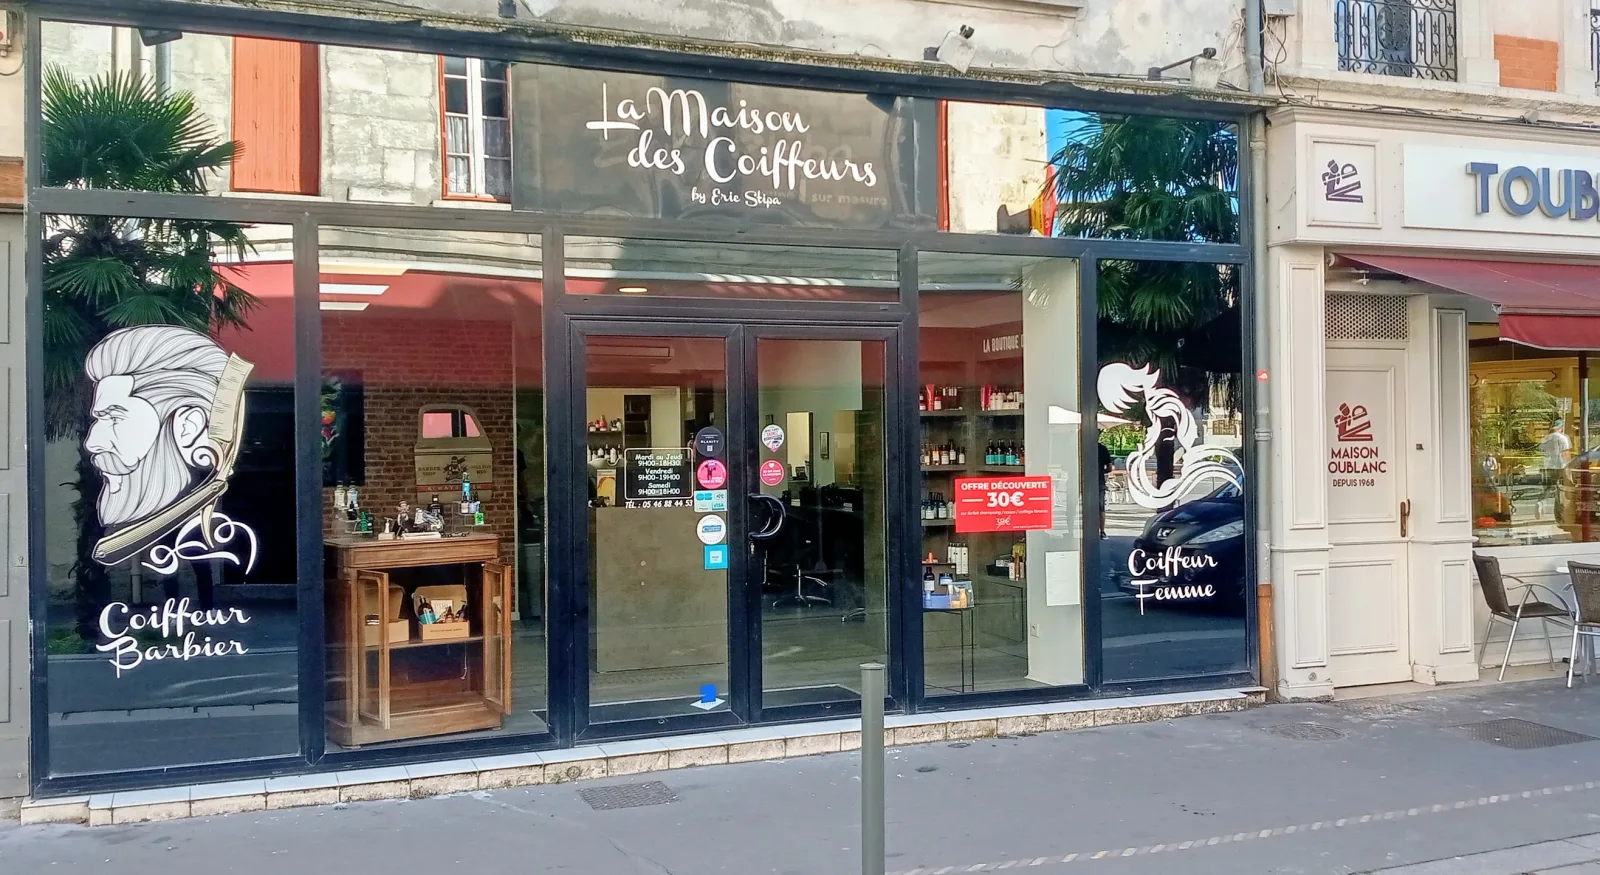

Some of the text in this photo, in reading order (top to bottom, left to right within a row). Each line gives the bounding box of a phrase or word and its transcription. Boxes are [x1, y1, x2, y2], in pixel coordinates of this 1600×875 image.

[586, 83, 810, 140] La Maison
[627, 130, 685, 175] des
[705, 137, 877, 190] Coiffeurs
[691, 187, 706, 204] by
[711, 188, 740, 205] Eric
[744, 190, 781, 208] Stipa
[1466, 162, 1600, 222] TOUB
[983, 339, 991, 353] LA
[992, 334, 1019, 352] BOUTIQUE
[1331, 446, 1379, 459] MAISON
[1328, 461, 1387, 474] OUBLANC
[991, 480, 1048, 489] DÉCOUVERTE
[1333, 479, 1375, 487] DEPUIS 1968
[987, 491, 1024, 507] 30€
[1128, 546, 1218, 576] Coiffeur
[1131, 579, 1216, 616] Femme
[99, 597, 252, 638] Coiffeur
[95, 632, 249, 679] Barbier
